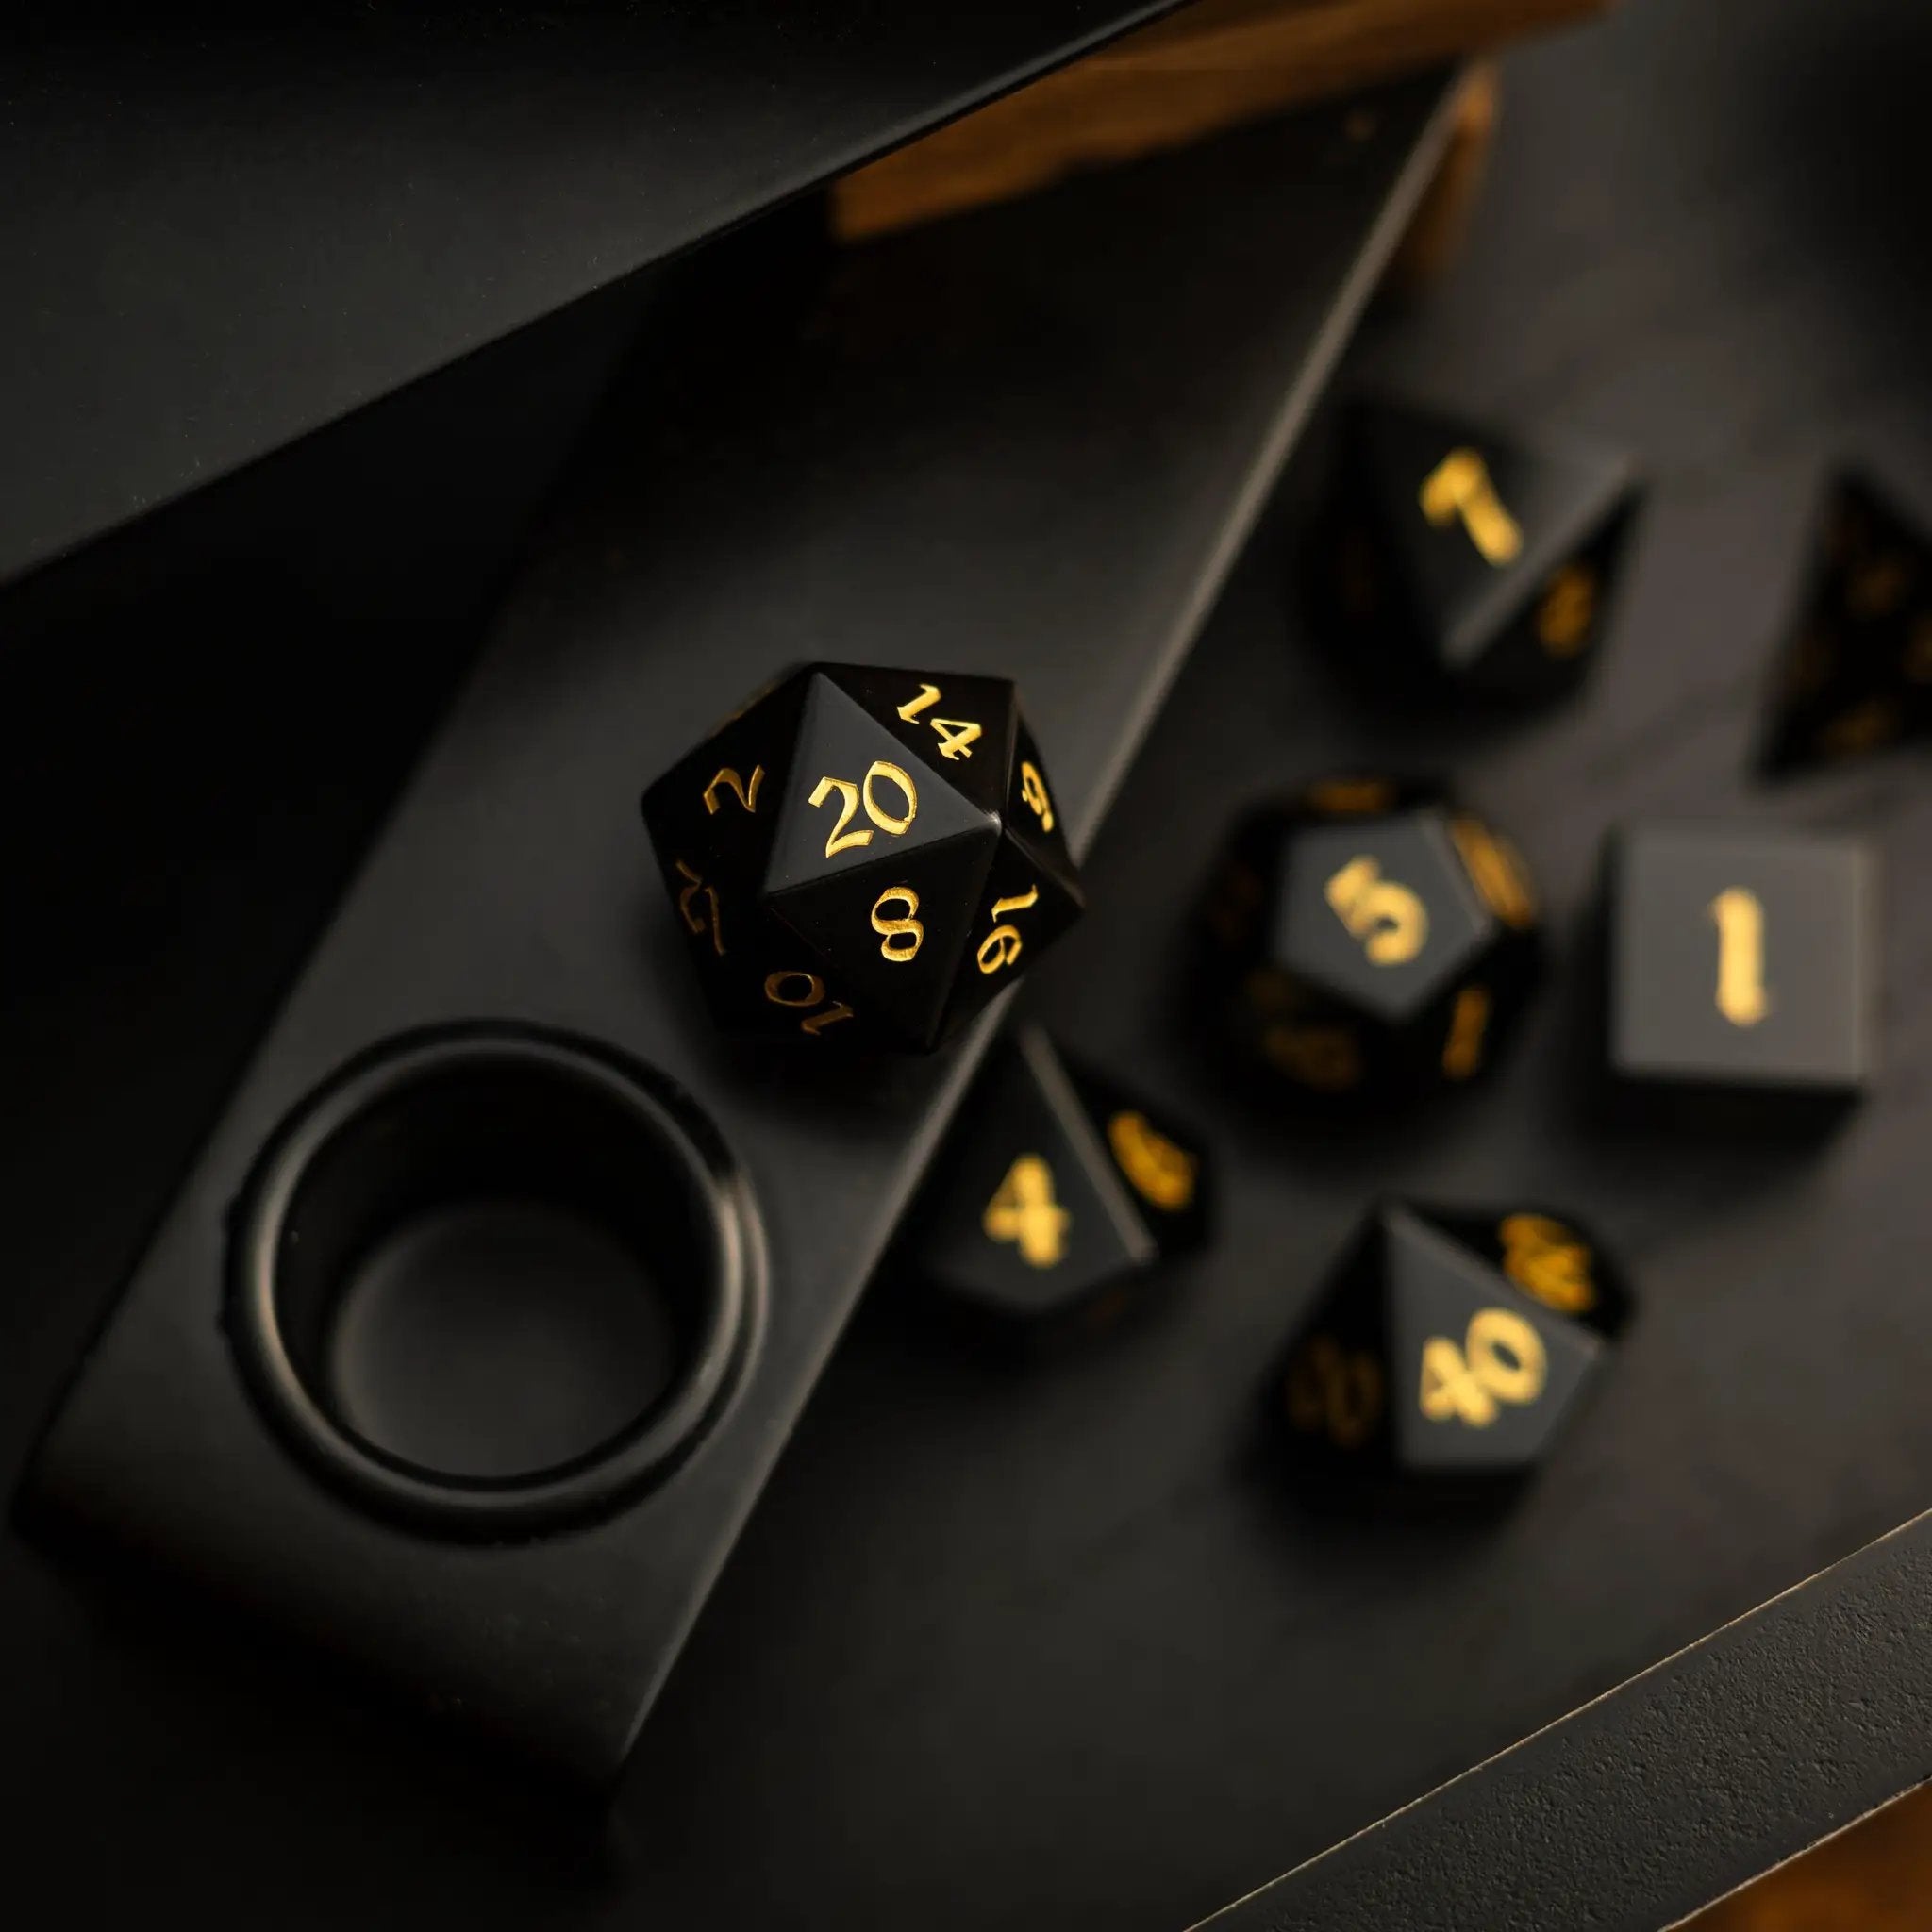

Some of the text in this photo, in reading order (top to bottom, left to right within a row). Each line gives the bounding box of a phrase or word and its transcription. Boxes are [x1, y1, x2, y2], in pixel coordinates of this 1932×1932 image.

[893, 681, 984, 761] 14
[702, 763, 766, 815] 2
[808, 760, 918, 858] 20
[870, 884, 925, 963] 8
[975, 882, 1040, 974] 16
[1324, 854, 1428, 966] 5
[1711, 885, 1768, 1026] 1
[762, 968, 856, 1036] 10
[984, 1153, 1070, 1268] 4
[1419, 1307, 1548, 1428] 40
